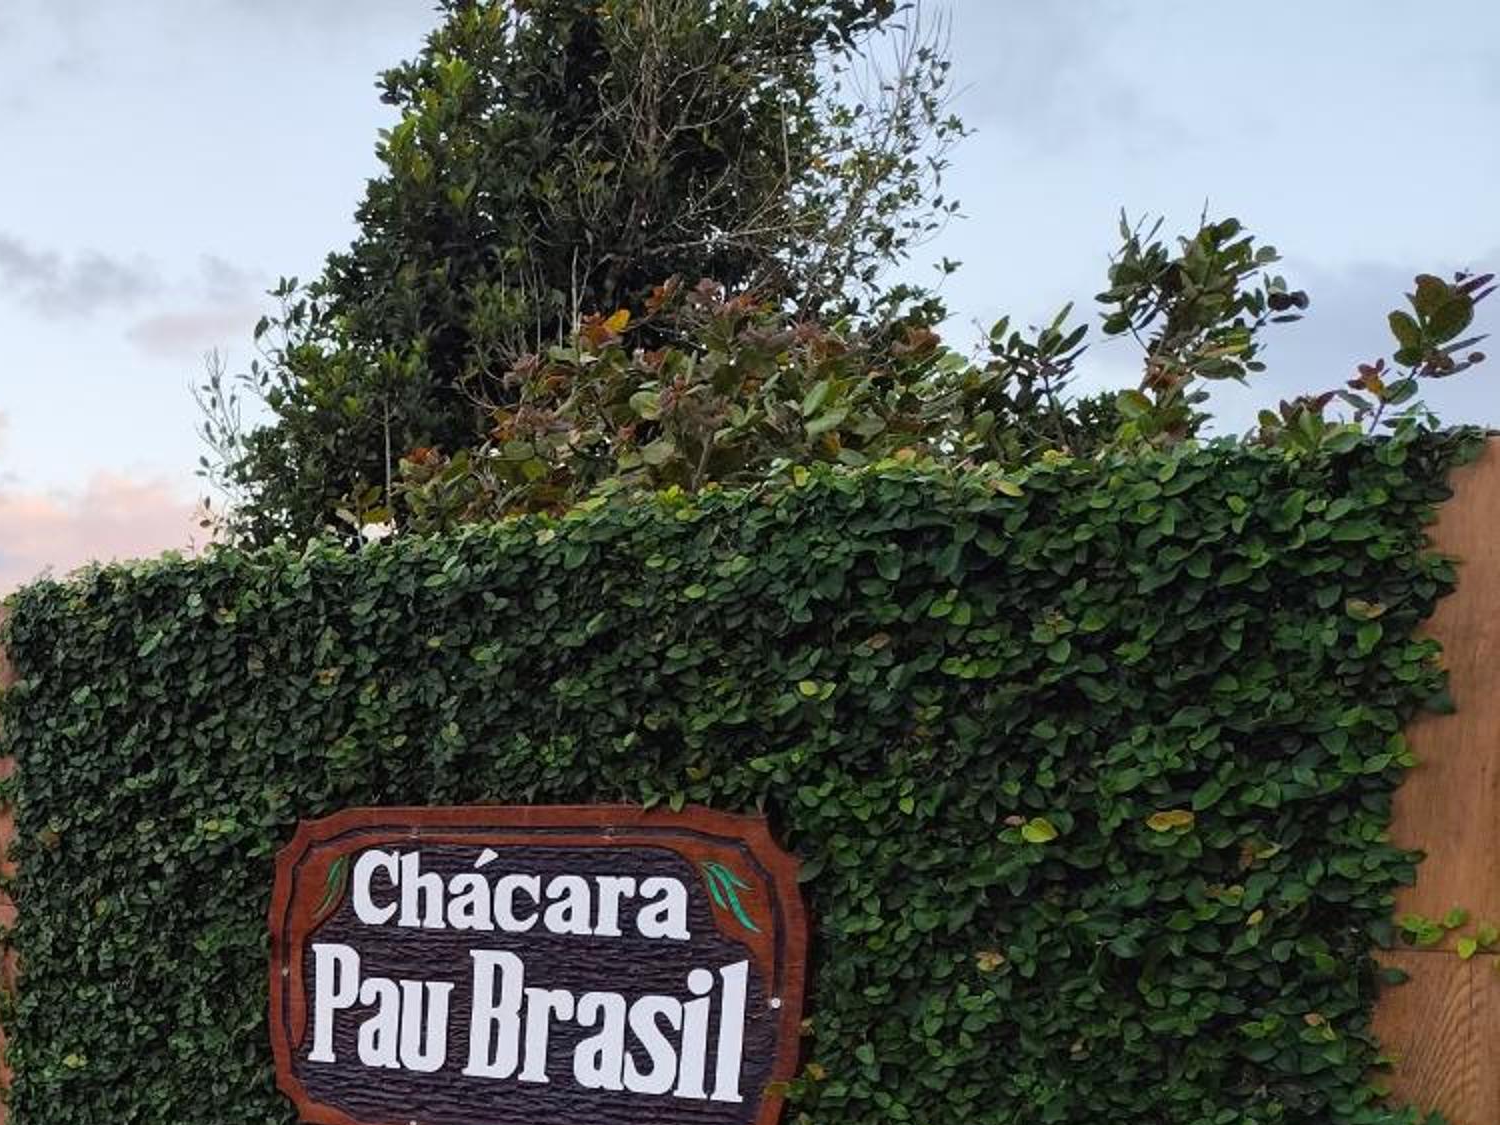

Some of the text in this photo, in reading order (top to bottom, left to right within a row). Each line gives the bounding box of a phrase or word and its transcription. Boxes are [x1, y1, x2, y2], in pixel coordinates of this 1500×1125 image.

[352, 848, 691, 941] Chácara
[307, 943, 749, 1103] Pau Brasil
